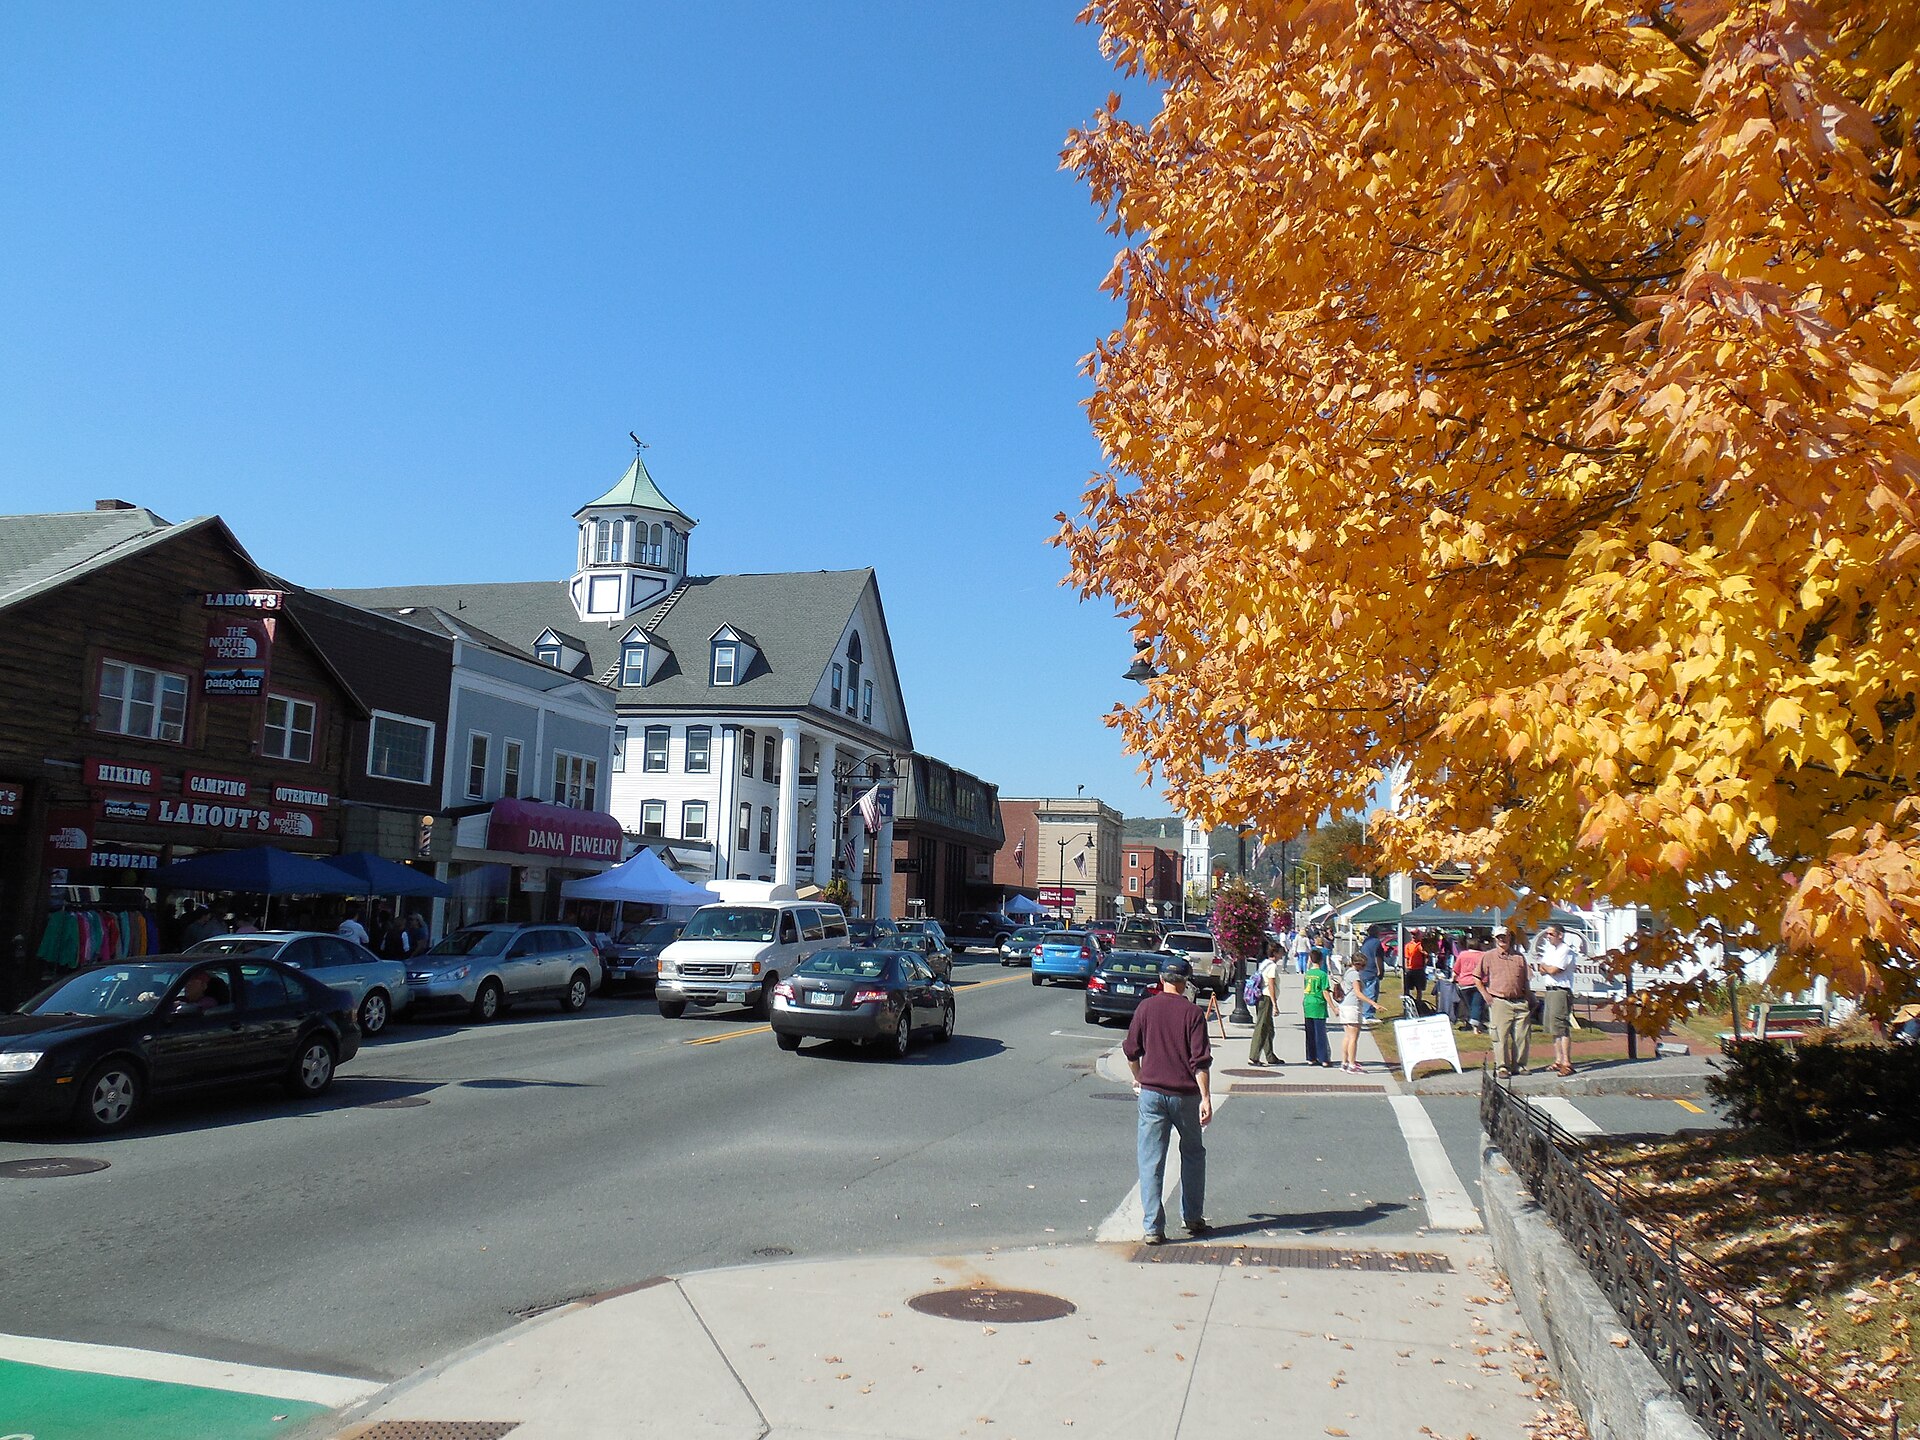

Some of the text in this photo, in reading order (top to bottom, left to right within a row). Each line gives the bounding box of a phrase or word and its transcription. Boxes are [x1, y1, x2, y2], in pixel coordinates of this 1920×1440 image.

[205, 592, 277, 608] LAHOUT'S
[226, 626, 248, 637] THE
[209, 637, 246, 648] NORTH
[217, 647, 245, 658] FACE
[205, 678, 260, 690] patagonia
[98, 764, 151, 786] HIKING
[190, 776, 247, 797] CAMPING
[275, 787, 329, 806] OUTERWEAR
[106, 806, 148, 817] patagonia
[158, 800, 270, 831] LAHOUT'S
[286, 811, 301, 820] THE
[273, 818, 300, 828] NORTH
[279, 826, 300, 836] FACE
[528, 829, 619, 857] DANA JEWELRY
